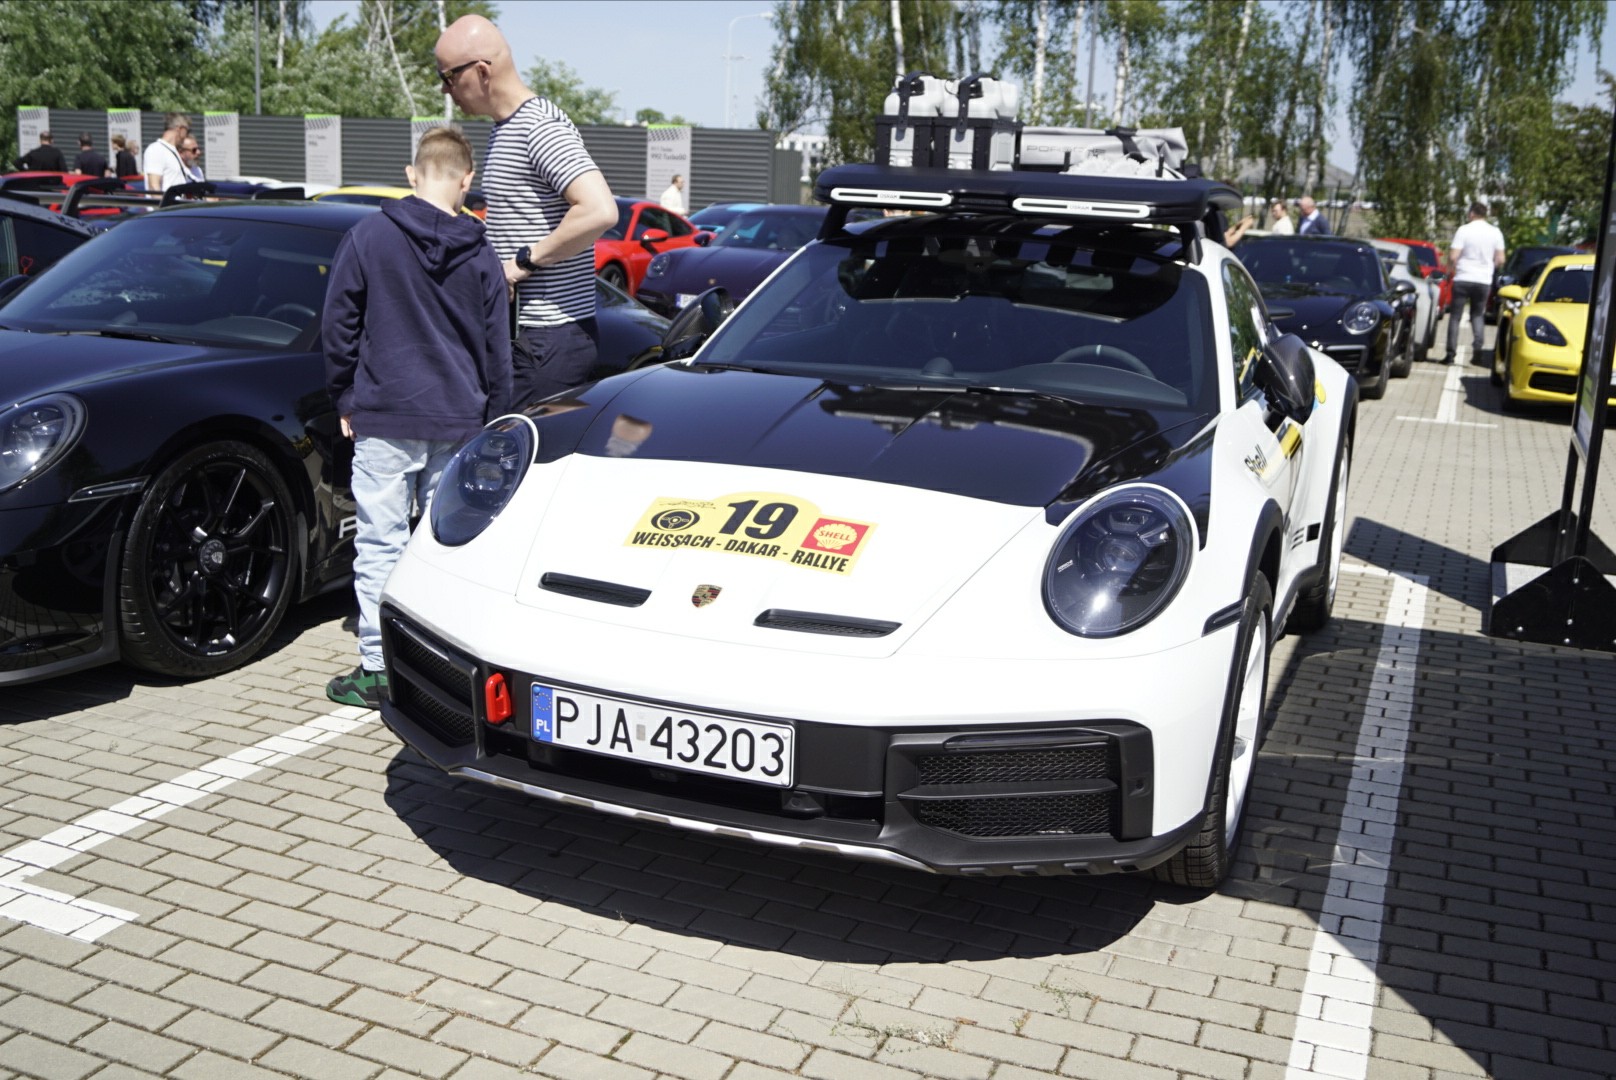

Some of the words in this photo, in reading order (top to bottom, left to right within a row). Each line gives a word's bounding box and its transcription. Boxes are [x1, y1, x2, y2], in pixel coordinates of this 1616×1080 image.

[718, 499, 799, 540] 19
[818, 530, 850, 541] SHELL
[632, 531, 715, 548] WEISSACH
[723, 539, 781, 556] DAKAR
[790, 549, 849, 572] RALLYE
[536, 718, 551, 732] PL
[556, 696, 633, 753] PJA
[650, 716, 784, 777] 43203
